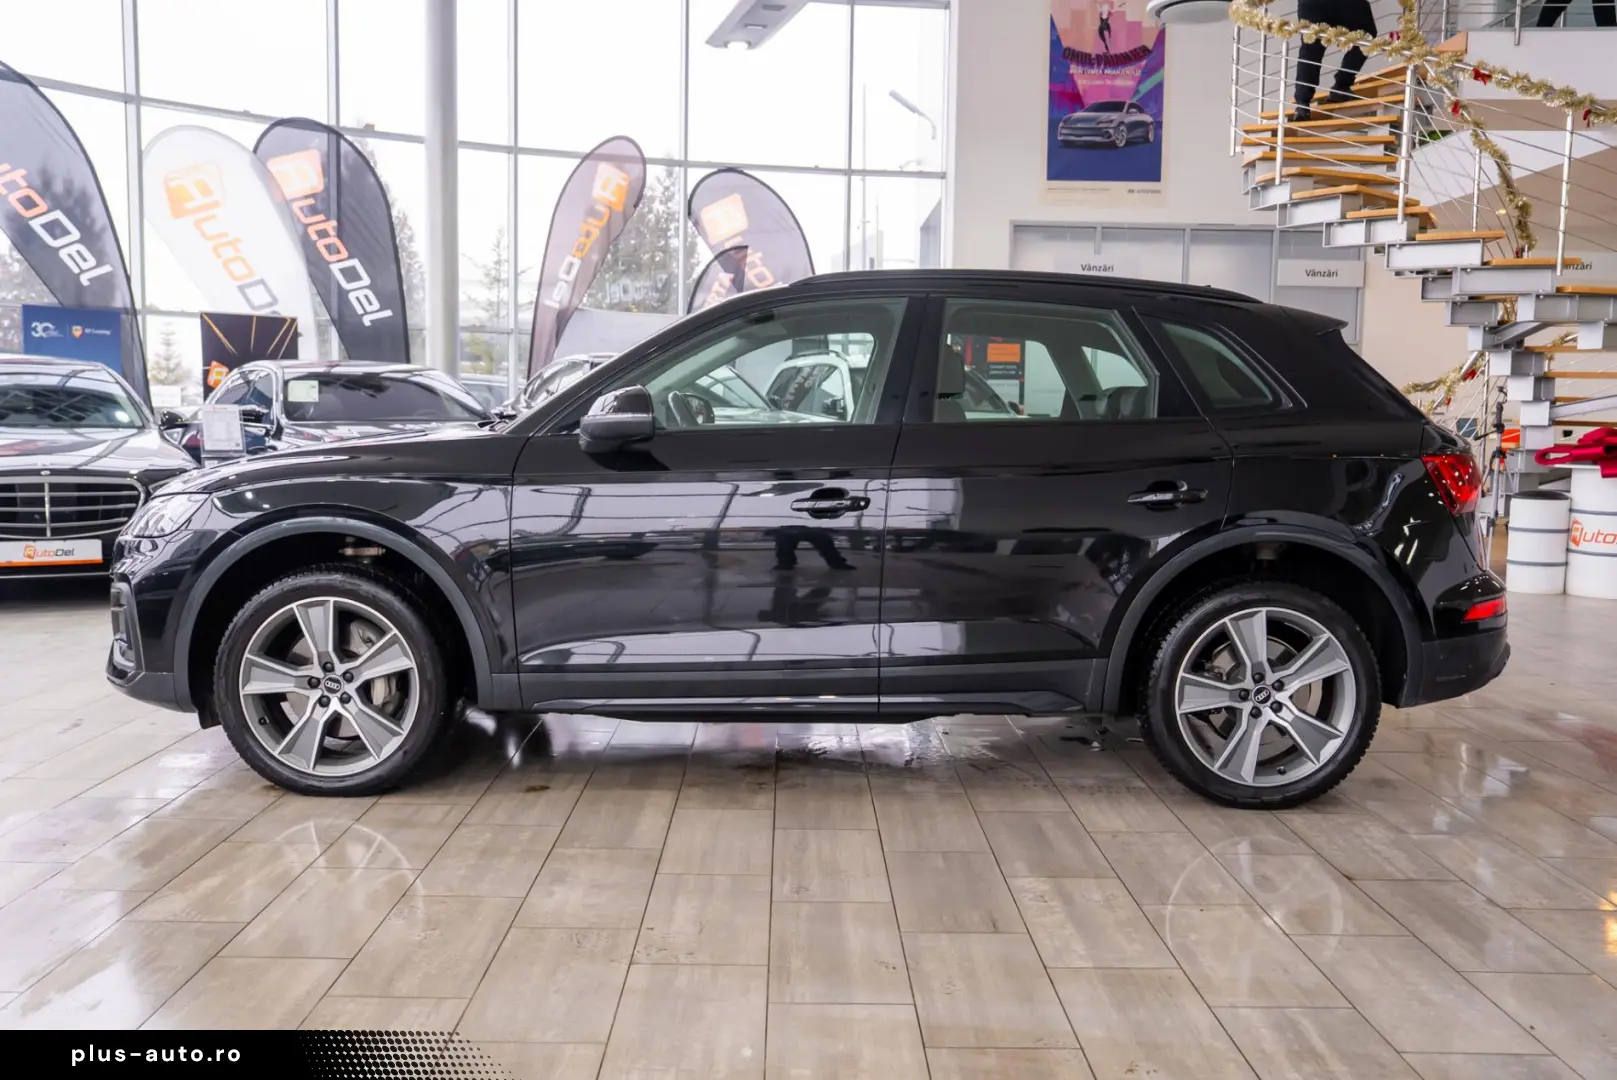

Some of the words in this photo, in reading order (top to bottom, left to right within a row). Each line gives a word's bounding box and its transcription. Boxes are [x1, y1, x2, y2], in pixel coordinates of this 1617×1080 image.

[0, 163, 113, 286] toDel
[164, 161, 281, 316] AutoD
[1080, 263, 1114, 272] Vânzări
[1305, 268, 1338, 277] Vânzări
[1563, 262, 1592, 270] nzări
[1570, 519, 1617, 547] Auto
[24, 544, 75, 559] AutoDel
